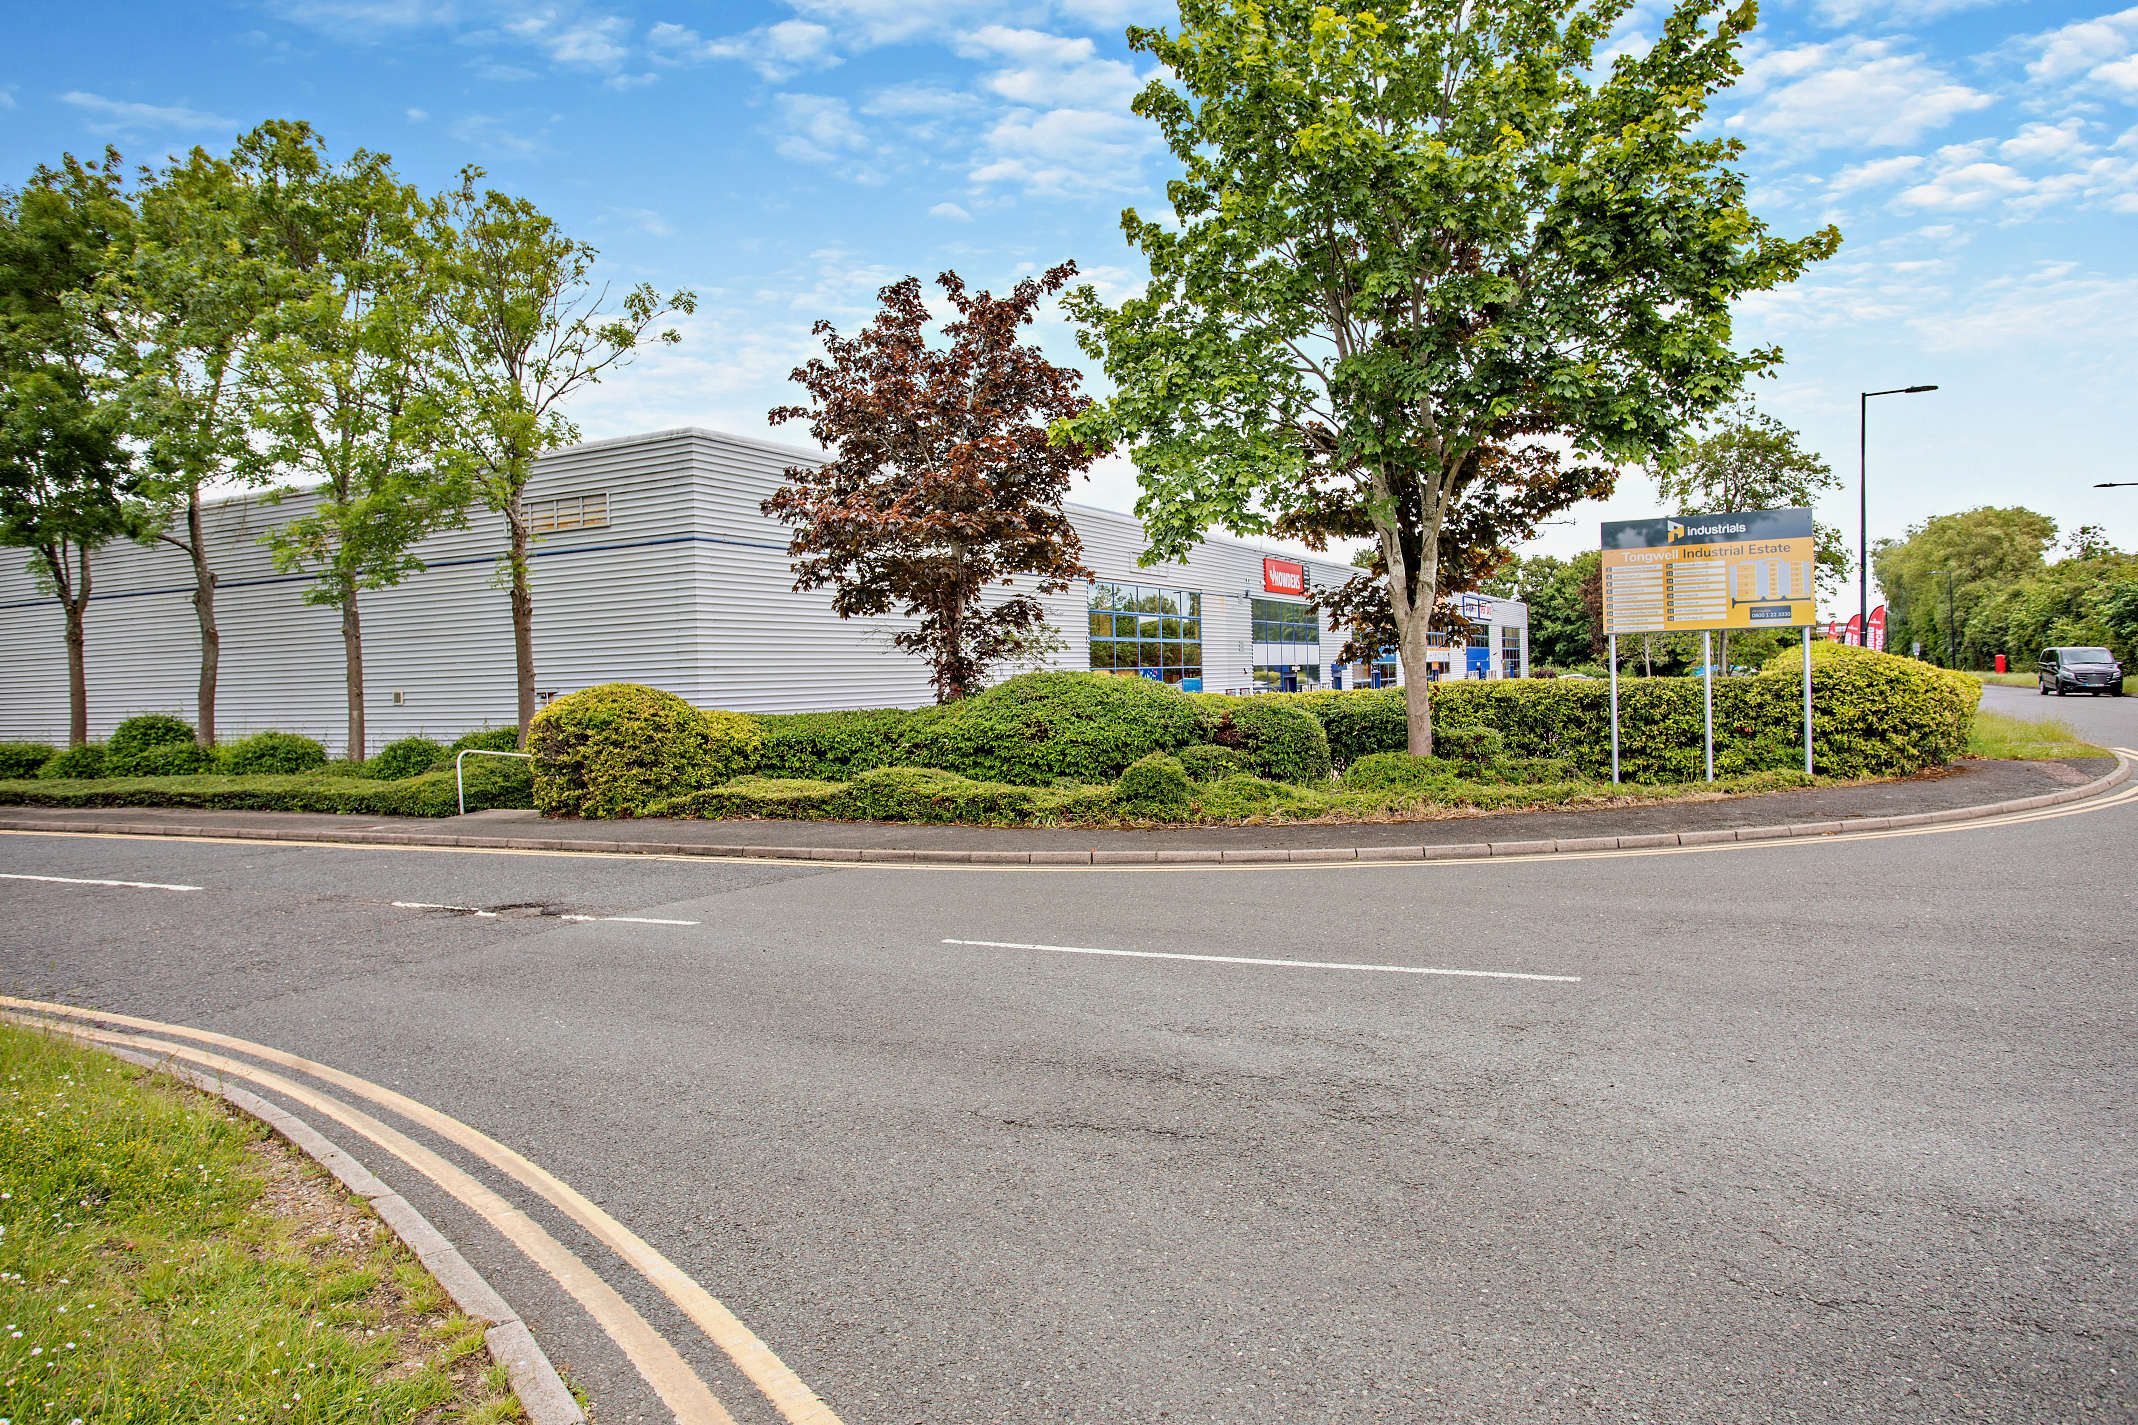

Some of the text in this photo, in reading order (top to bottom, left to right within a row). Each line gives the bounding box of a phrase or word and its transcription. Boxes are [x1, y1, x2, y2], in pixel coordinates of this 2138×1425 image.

[1687, 523, 1746, 537] industrials
[1622, 543, 1791, 564] Tongwell Industrial Estate
